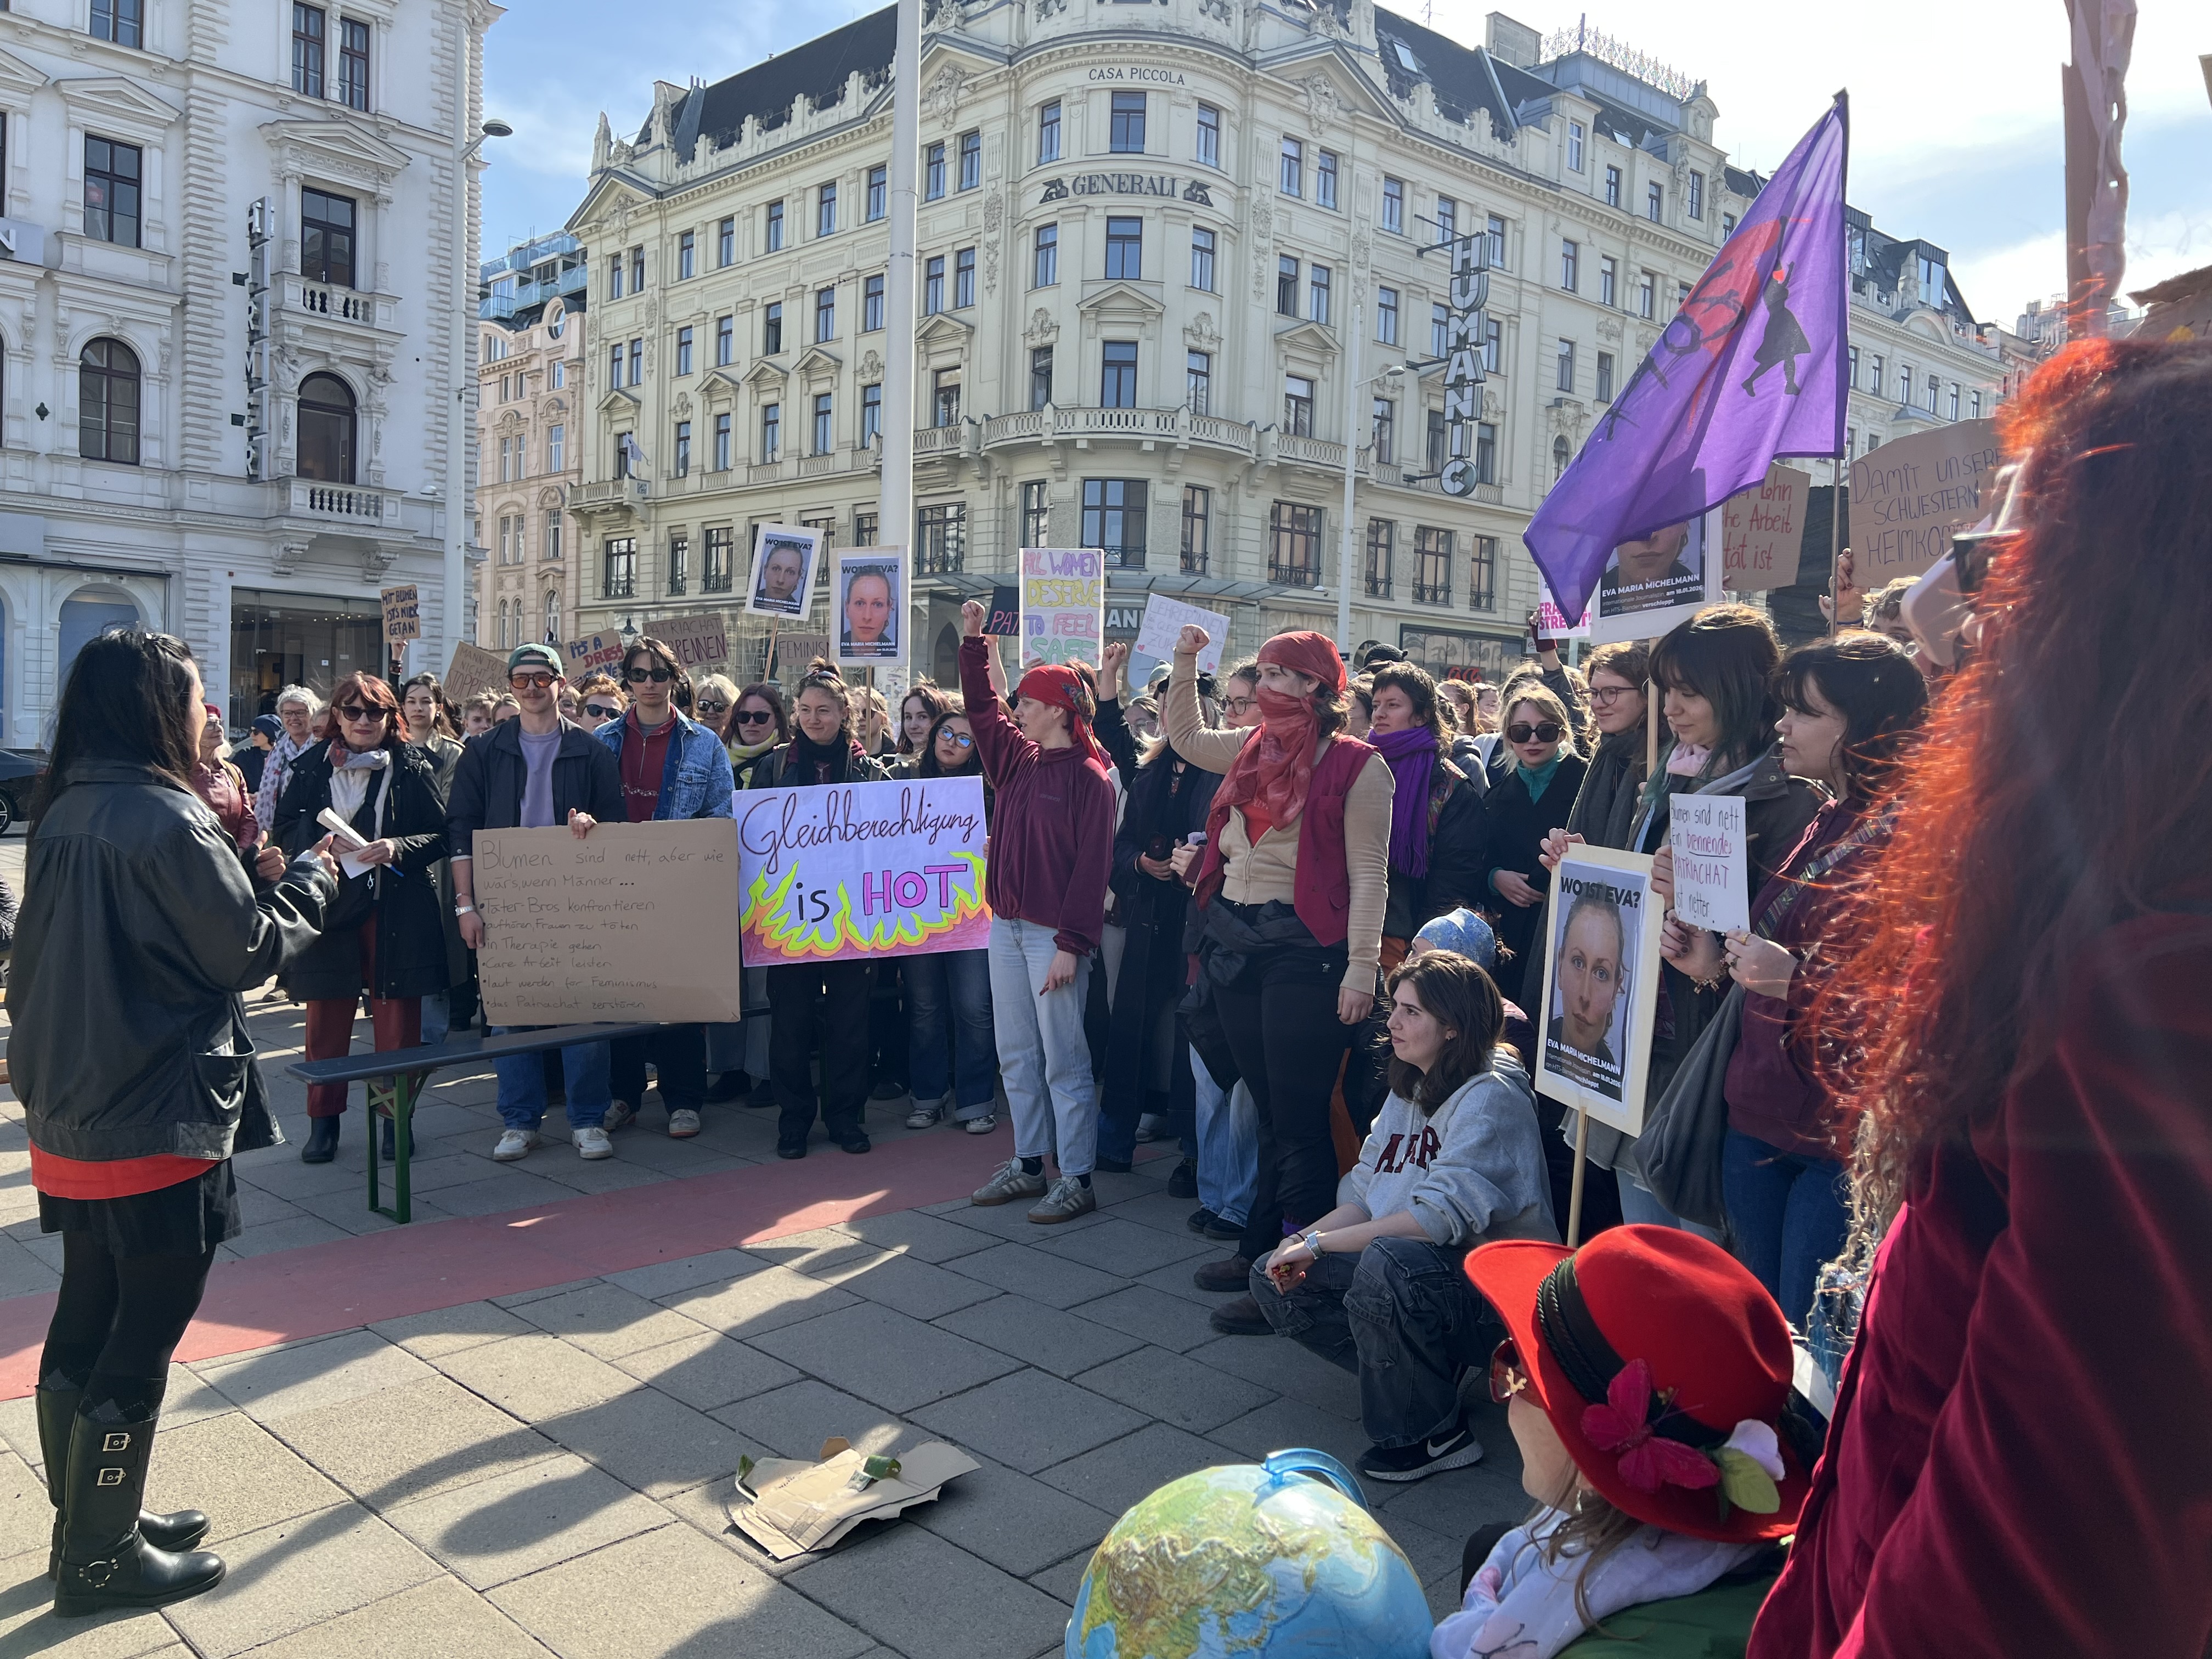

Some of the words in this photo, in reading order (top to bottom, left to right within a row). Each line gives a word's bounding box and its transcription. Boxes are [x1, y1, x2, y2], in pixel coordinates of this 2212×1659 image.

[1089, 67, 1124, 80] CASA
[1130, 68, 1184, 85] PICCOLA
[1072, 173, 1176, 197] GENERALI
[1440, 234, 1490, 497] HUMANIC
[1761, 470, 1792, 501] Lohn
[1874, 475, 1979, 525] SCHWESTERN
[1750, 503, 1792, 533] Arbeit
[1022, 551, 1047, 575] ALL
[1049, 551, 1102, 577] WOMEN
[1753, 542, 1773, 571] ist
[878, 565, 899, 573] EVA?
[1026, 578, 1103, 608] DESERVE
[1602, 589, 1616, 597] EVA
[1618, 583, 1644, 594] MARIA
[1646, 574, 1700, 590] MICHELMANN
[1602, 597, 1634, 606] Internationale
[1676, 585, 1703, 594] 18.01.2026
[382, 591, 394, 606] MIT
[396, 589, 417, 603] BLUMEN
[1611, 604, 1642, 613] HTS-Banden
[1642, 599, 1674, 608] verschleppt
[389, 620, 415, 636] GETAN
[645, 618, 721, 636] PATRIACHAT
[1023, 615, 1045, 636] TO
[1053, 613, 1101, 638] FEEL
[1539, 612, 1592, 630] STRET!
[594, 636, 602, 650] A
[1031, 637, 1097, 665] SAFE
[459, 647, 484, 665] MANN
[583, 642, 624, 668] DRESS
[460, 661, 488, 678] NICHT
[443, 668, 488, 698] STOPPT
[1695, 803, 1711, 826] sind
[741, 786, 980, 874] Gleichberechtigung
[482, 840, 553, 870] Blumen
[575, 846, 606, 864] sind
[625, 849, 651, 866] nett,
[658, 847, 696, 863] aber
[704, 849, 724, 862] wie
[1674, 853, 1729, 889] PATRIACHAT
[795, 882, 830, 923] is
[862, 864, 968, 916] HOT
[1561, 876, 1583, 896] WO
[1585, 882, 1603, 900] IST
[1604, 885, 1641, 909] EVA?
[568, 897, 655, 913] konfrontieren
[535, 918, 571, 929] Frauen
[487, 938, 498, 950] in
[501, 936, 558, 953] Therapie
[568, 939, 601, 953] gehen
[486, 957, 516, 968] Care
[572, 957, 612, 968] leisten
[488, 974, 512, 988] laut
[518, 975, 554, 988] werden
[591, 975, 657, 988] Feminismus
[490, 997, 508, 1008] das
[1547, 1038, 1559, 1050] EVA
[1560, 1043, 1577, 1058] MARIA
